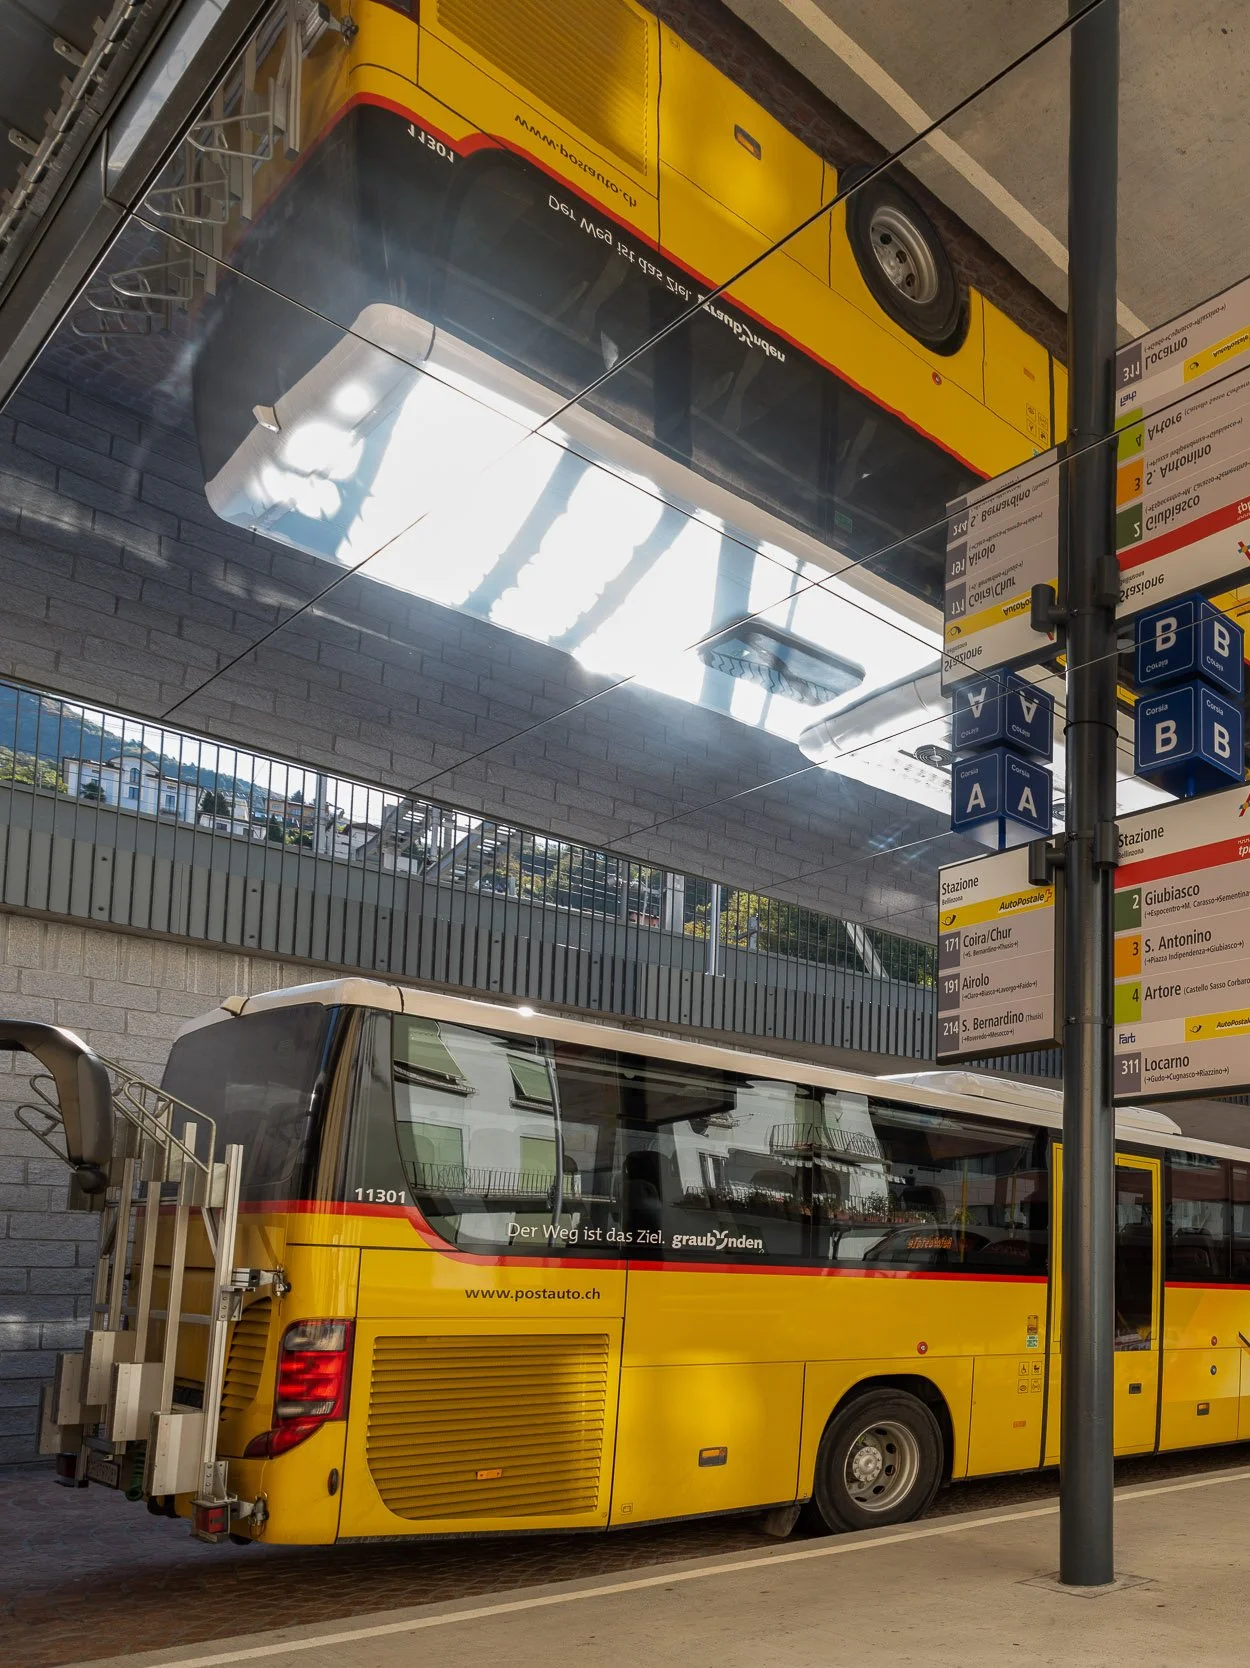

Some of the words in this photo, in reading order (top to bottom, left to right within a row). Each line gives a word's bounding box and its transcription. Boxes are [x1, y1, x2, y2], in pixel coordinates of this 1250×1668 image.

[1145, 703, 1169, 716] Corsia
[1206, 699, 1224, 716] Corsia
[1155, 719, 1178, 754] B
[1213, 721, 1231, 759] B
[960, 767, 979, 779] Corsia
[1011, 764, 1031, 778] Corsia
[966, 782, 986, 813] A
[1017, 787, 1037, 818] A
[1118, 827, 1164, 848] Stazione
[942, 877, 979, 895] Stazione
[999, 893, 1045, 911] AutoPostale
[1132, 894, 1140, 910] 2
[1145, 884, 1200, 906] Giubiasco
[945, 937, 959, 952] 171
[963, 927, 1012, 948] Coira/Chur
[1132, 941, 1139, 956] 3
[1144, 938, 1155, 953] S.
[1158, 928, 1212, 951] Antonino
[944, 979, 958, 994] 191
[962, 973, 989, 990] Airolo
[1132, 988, 1139, 1002] 4
[1145, 984, 1181, 1000] Artore
[1184, 984, 1209, 995] (Castello
[1209, 981, 1226, 990] Sasso
[944, 1021, 959, 1036] 214
[962, 1019, 970, 1033] S.
[973, 1011, 1025, 1030] Bernardino
[1025, 1012, 1043, 1022] (Thusis)
[1121, 1059, 1139, 1075] 311
[1144, 1055, 1190, 1072] Locarno
[354, 1187, 407, 1205] 11301
[507, 1222, 538, 1238] Der
[542, 1224, 579, 1245] Weg
[583, 1225, 603, 1242] ist
[606, 1227, 633, 1244] das
[637, 1229, 665, 1245] Ziel.
[464, 1287, 601, 1302] www.postauto.ch
